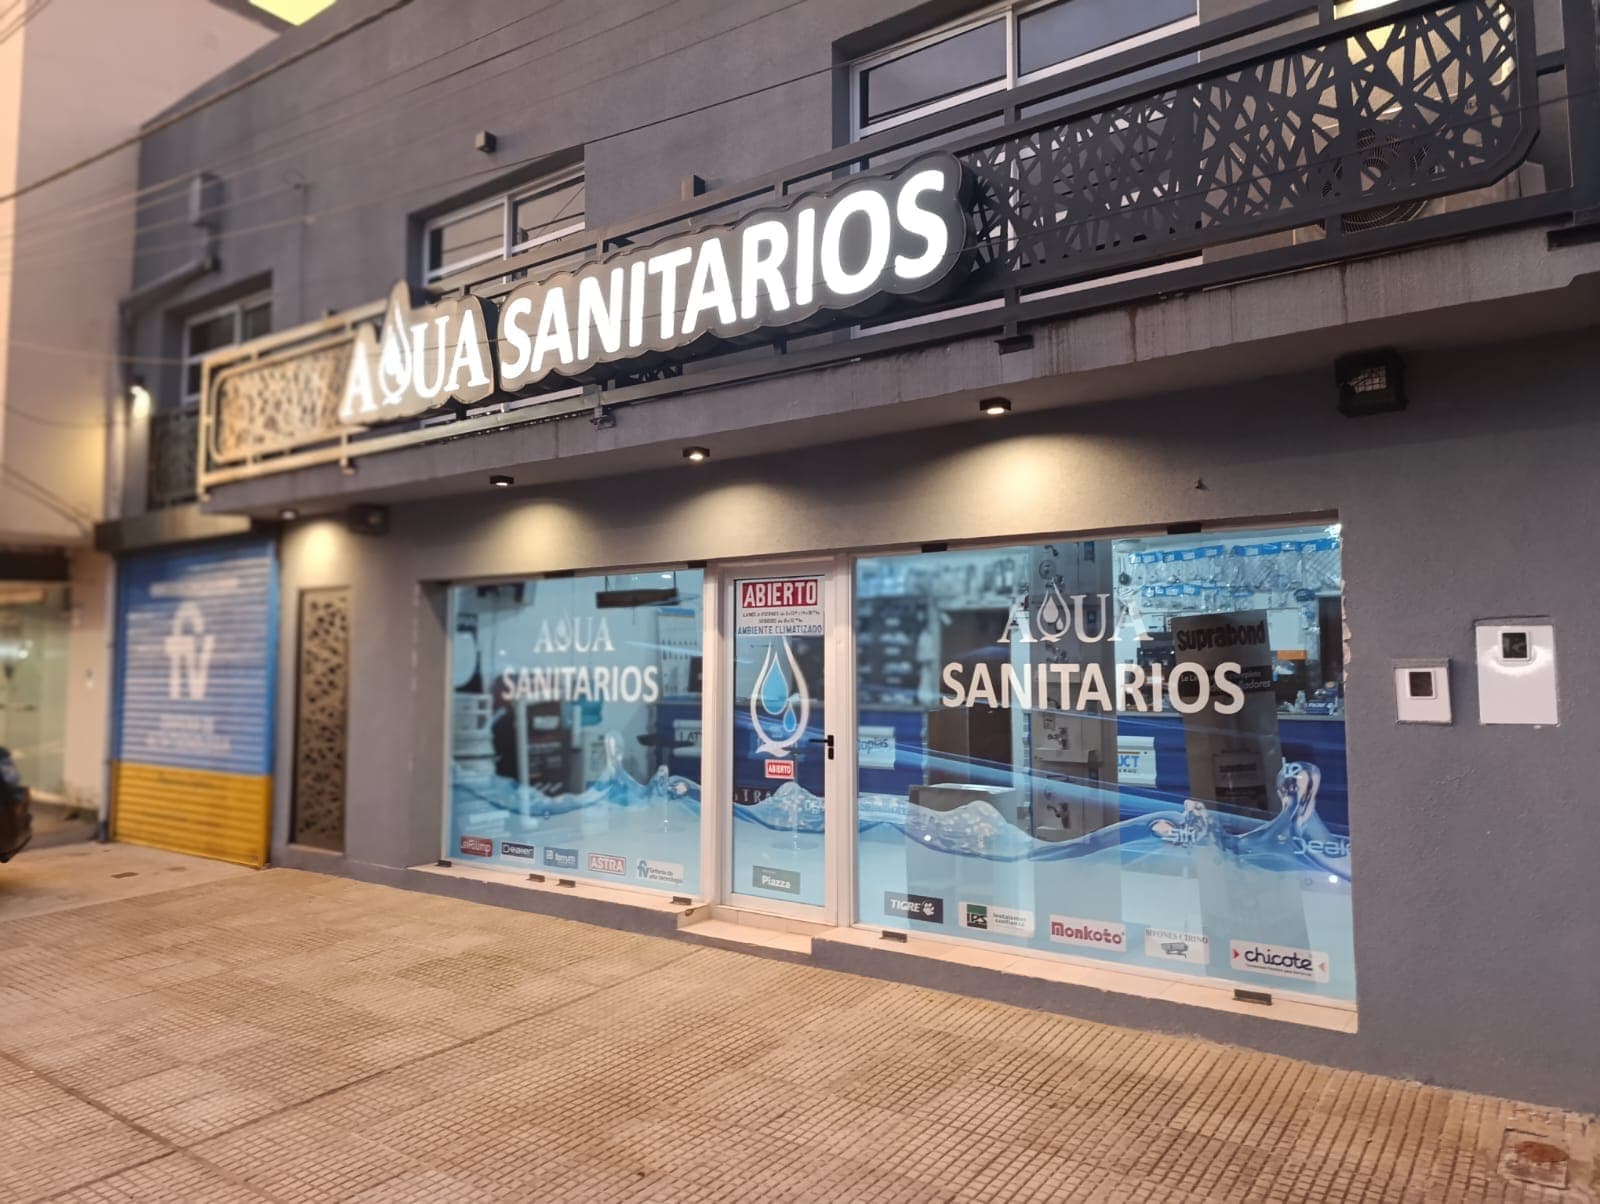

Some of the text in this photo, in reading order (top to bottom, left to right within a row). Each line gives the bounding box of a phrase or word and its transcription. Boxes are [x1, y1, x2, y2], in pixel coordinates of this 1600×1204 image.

[340, 169, 948, 421] AQUA SANITARIOS
[743, 583, 817, 607] ABIERTO
[997, 580, 1155, 644] AQUA
[533, 609, 615, 653] AQUA
[737, 623, 823, 635] AMBIENTE CLIMATIZADO
[1177, 619, 1266, 652] suprabond
[502, 664, 659, 703] SANITARIOS
[940, 662, 1246, 715] SANITARIOS
[768, 764, 791, 776] ABIERTO
[591, 856, 624, 872] ASTRA
[761, 875, 791, 889] Piazza
[890, 899, 921, 913] TIGRE
[967, 912, 987, 924] IPS
[1051, 921, 1122, 944] Monkoto
[1244, 947, 1312, 971] chicote
